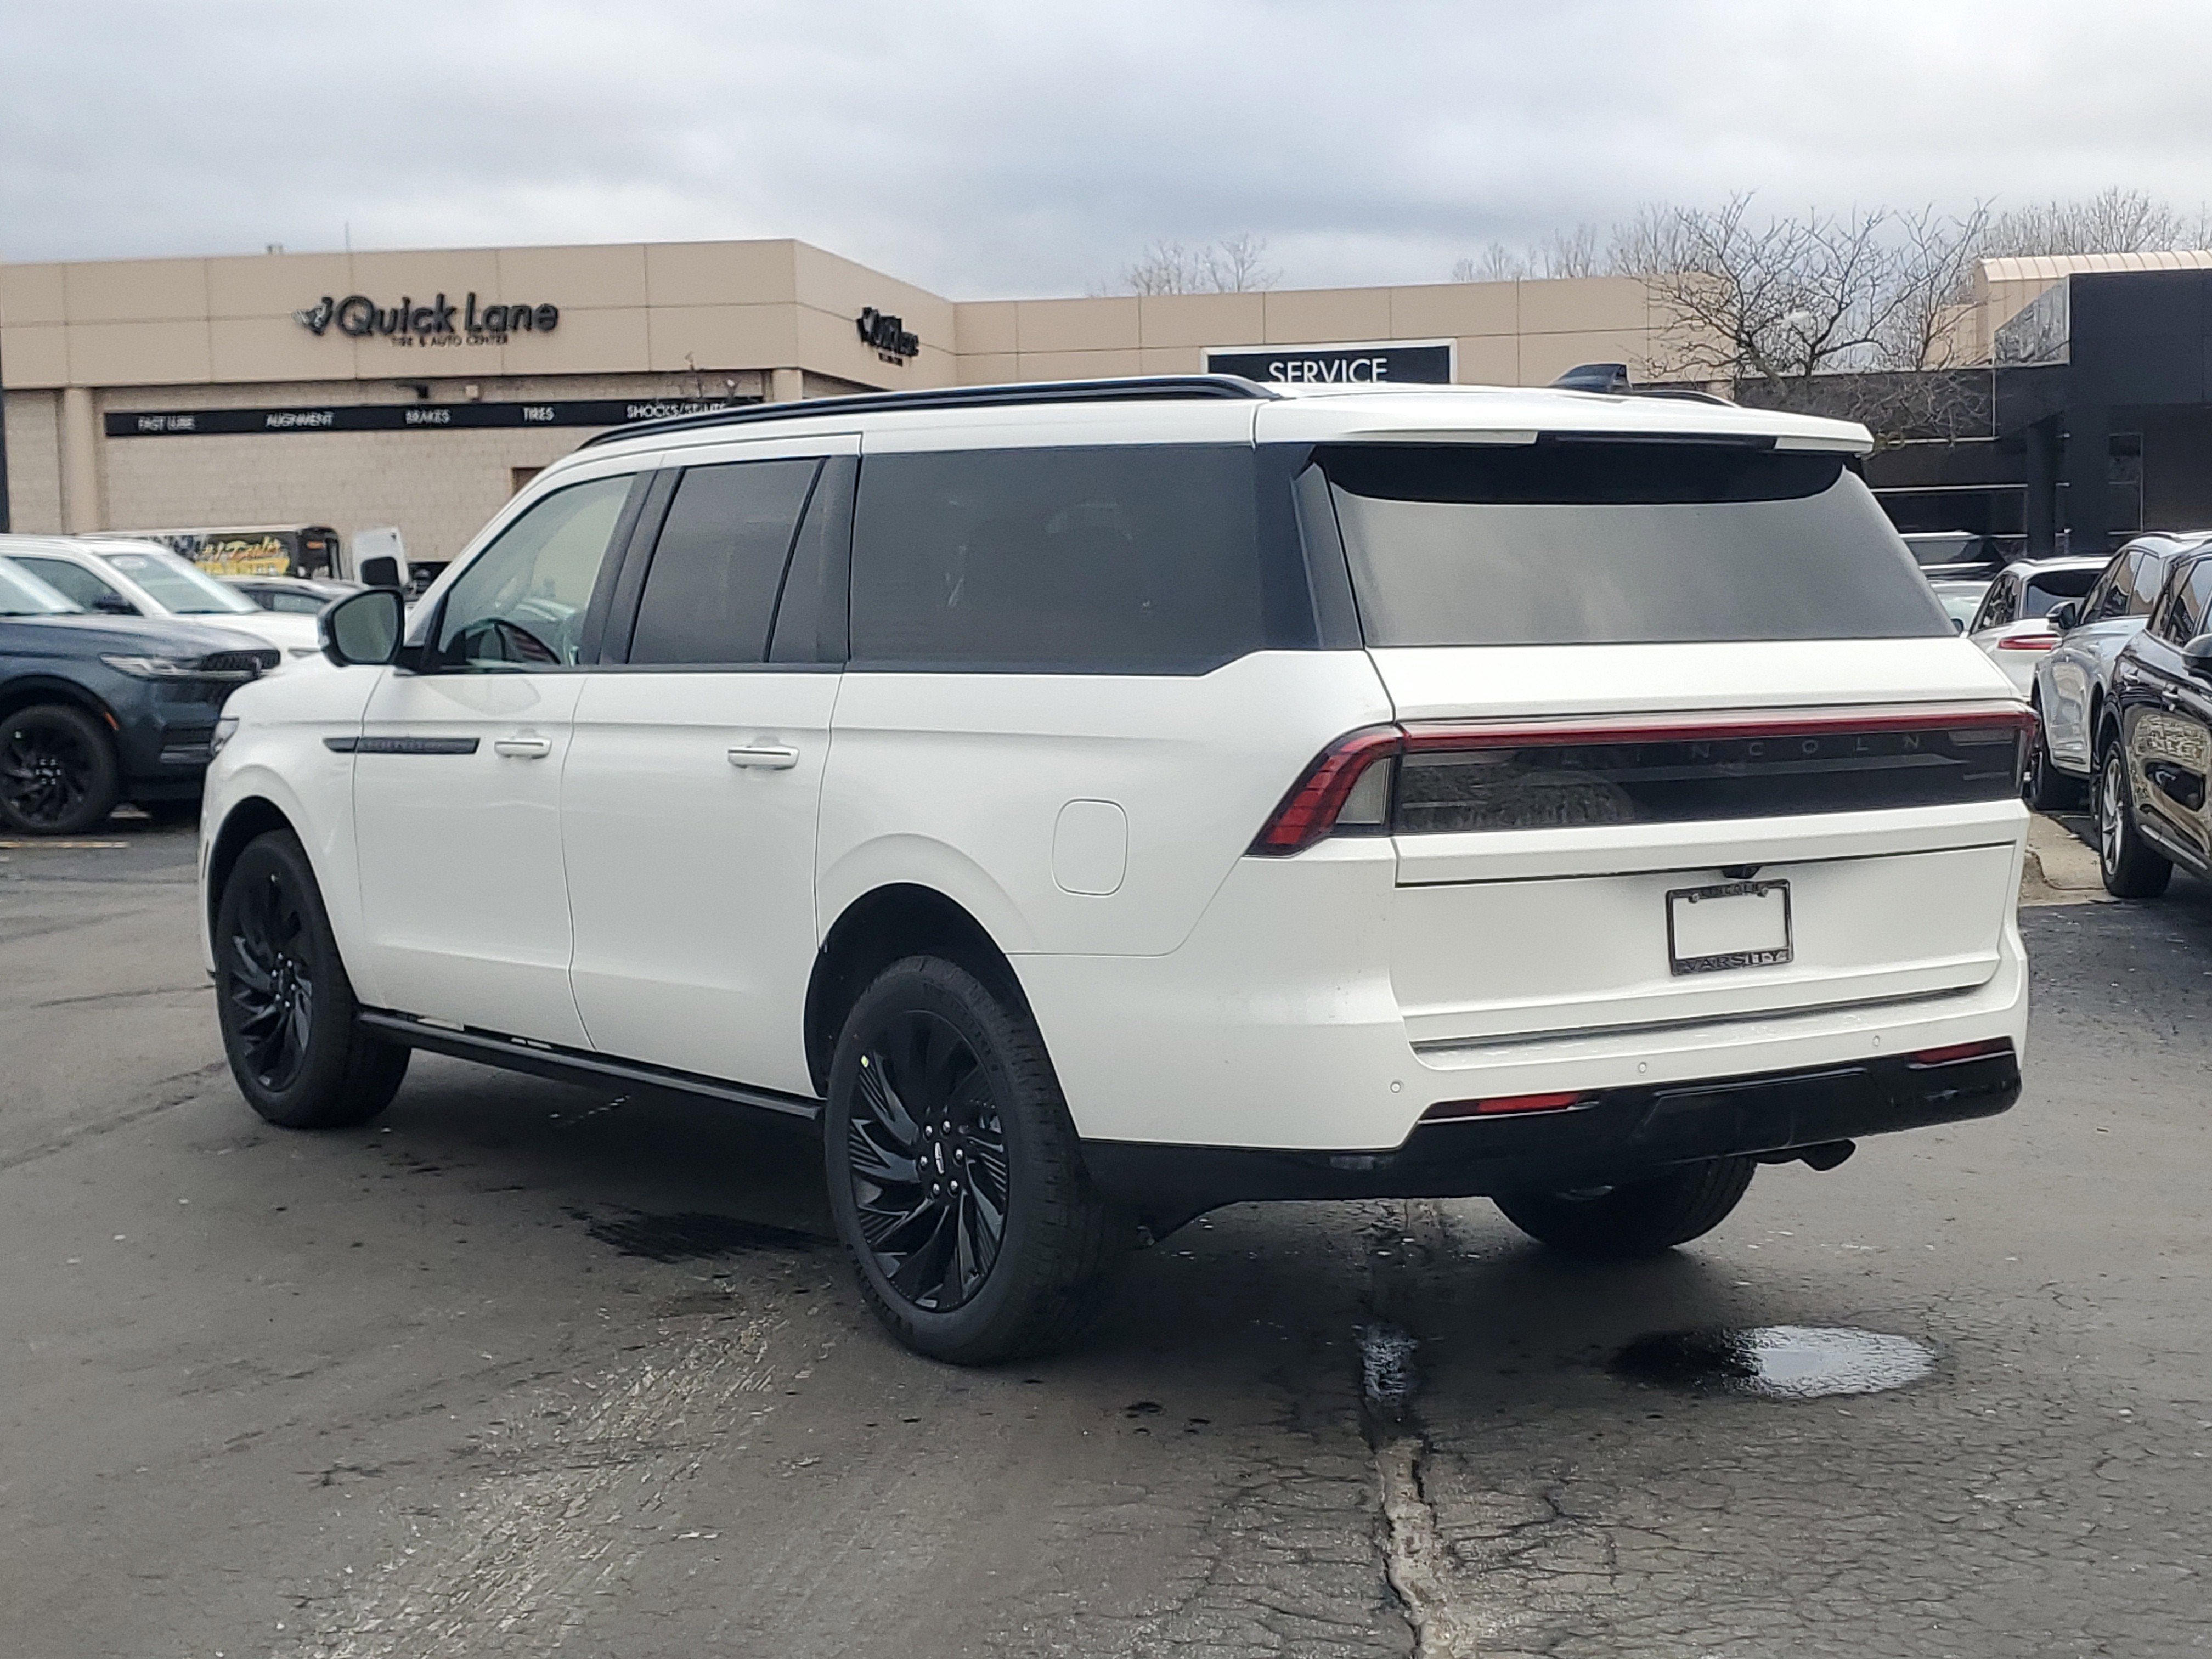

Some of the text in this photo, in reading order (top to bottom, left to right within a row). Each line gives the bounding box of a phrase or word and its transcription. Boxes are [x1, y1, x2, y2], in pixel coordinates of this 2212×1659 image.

[336, 292, 558, 336] Quick Lane
[1269, 358, 1387, 383] SERVICE
[266, 411, 334, 427] ALIGNMENT
[406, 409, 450, 425] BRAKES
[522, 407, 555, 422] TIRES
[1562, 734, 1920, 765] LINCOLN
[1686, 951, 1780, 971] VARSITY
